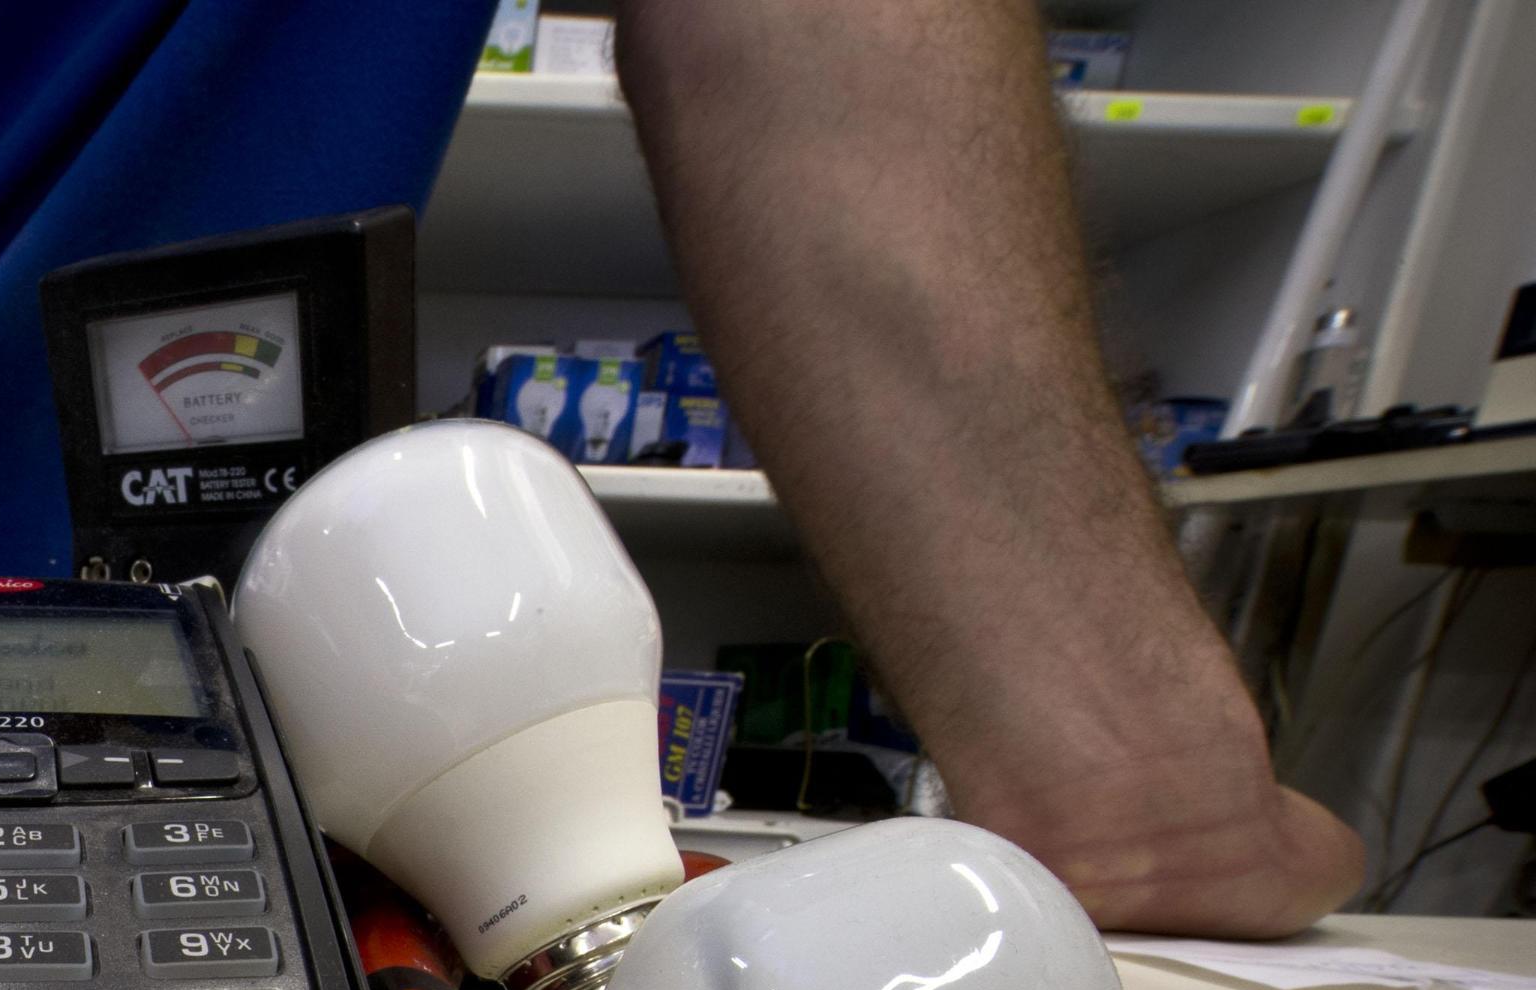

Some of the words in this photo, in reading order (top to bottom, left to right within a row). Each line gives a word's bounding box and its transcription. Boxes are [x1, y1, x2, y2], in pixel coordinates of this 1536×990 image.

[184, 391, 243, 409] BATTERY
[190, 413, 235, 426] CHECKER
[121, 467, 193, 506] CAT
[199, 480, 230, 490] BATTERY
[231, 478, 257, 488] TESTER
[200, 491, 224, 501] MADE
[225, 491, 234, 500] IN
[235, 489, 263, 499] CHINA
[664, 743, 686, 782] GM
[164, 823, 190, 843] 3
[169, 876, 197, 898] 6
[179, 933, 209, 956] 9
